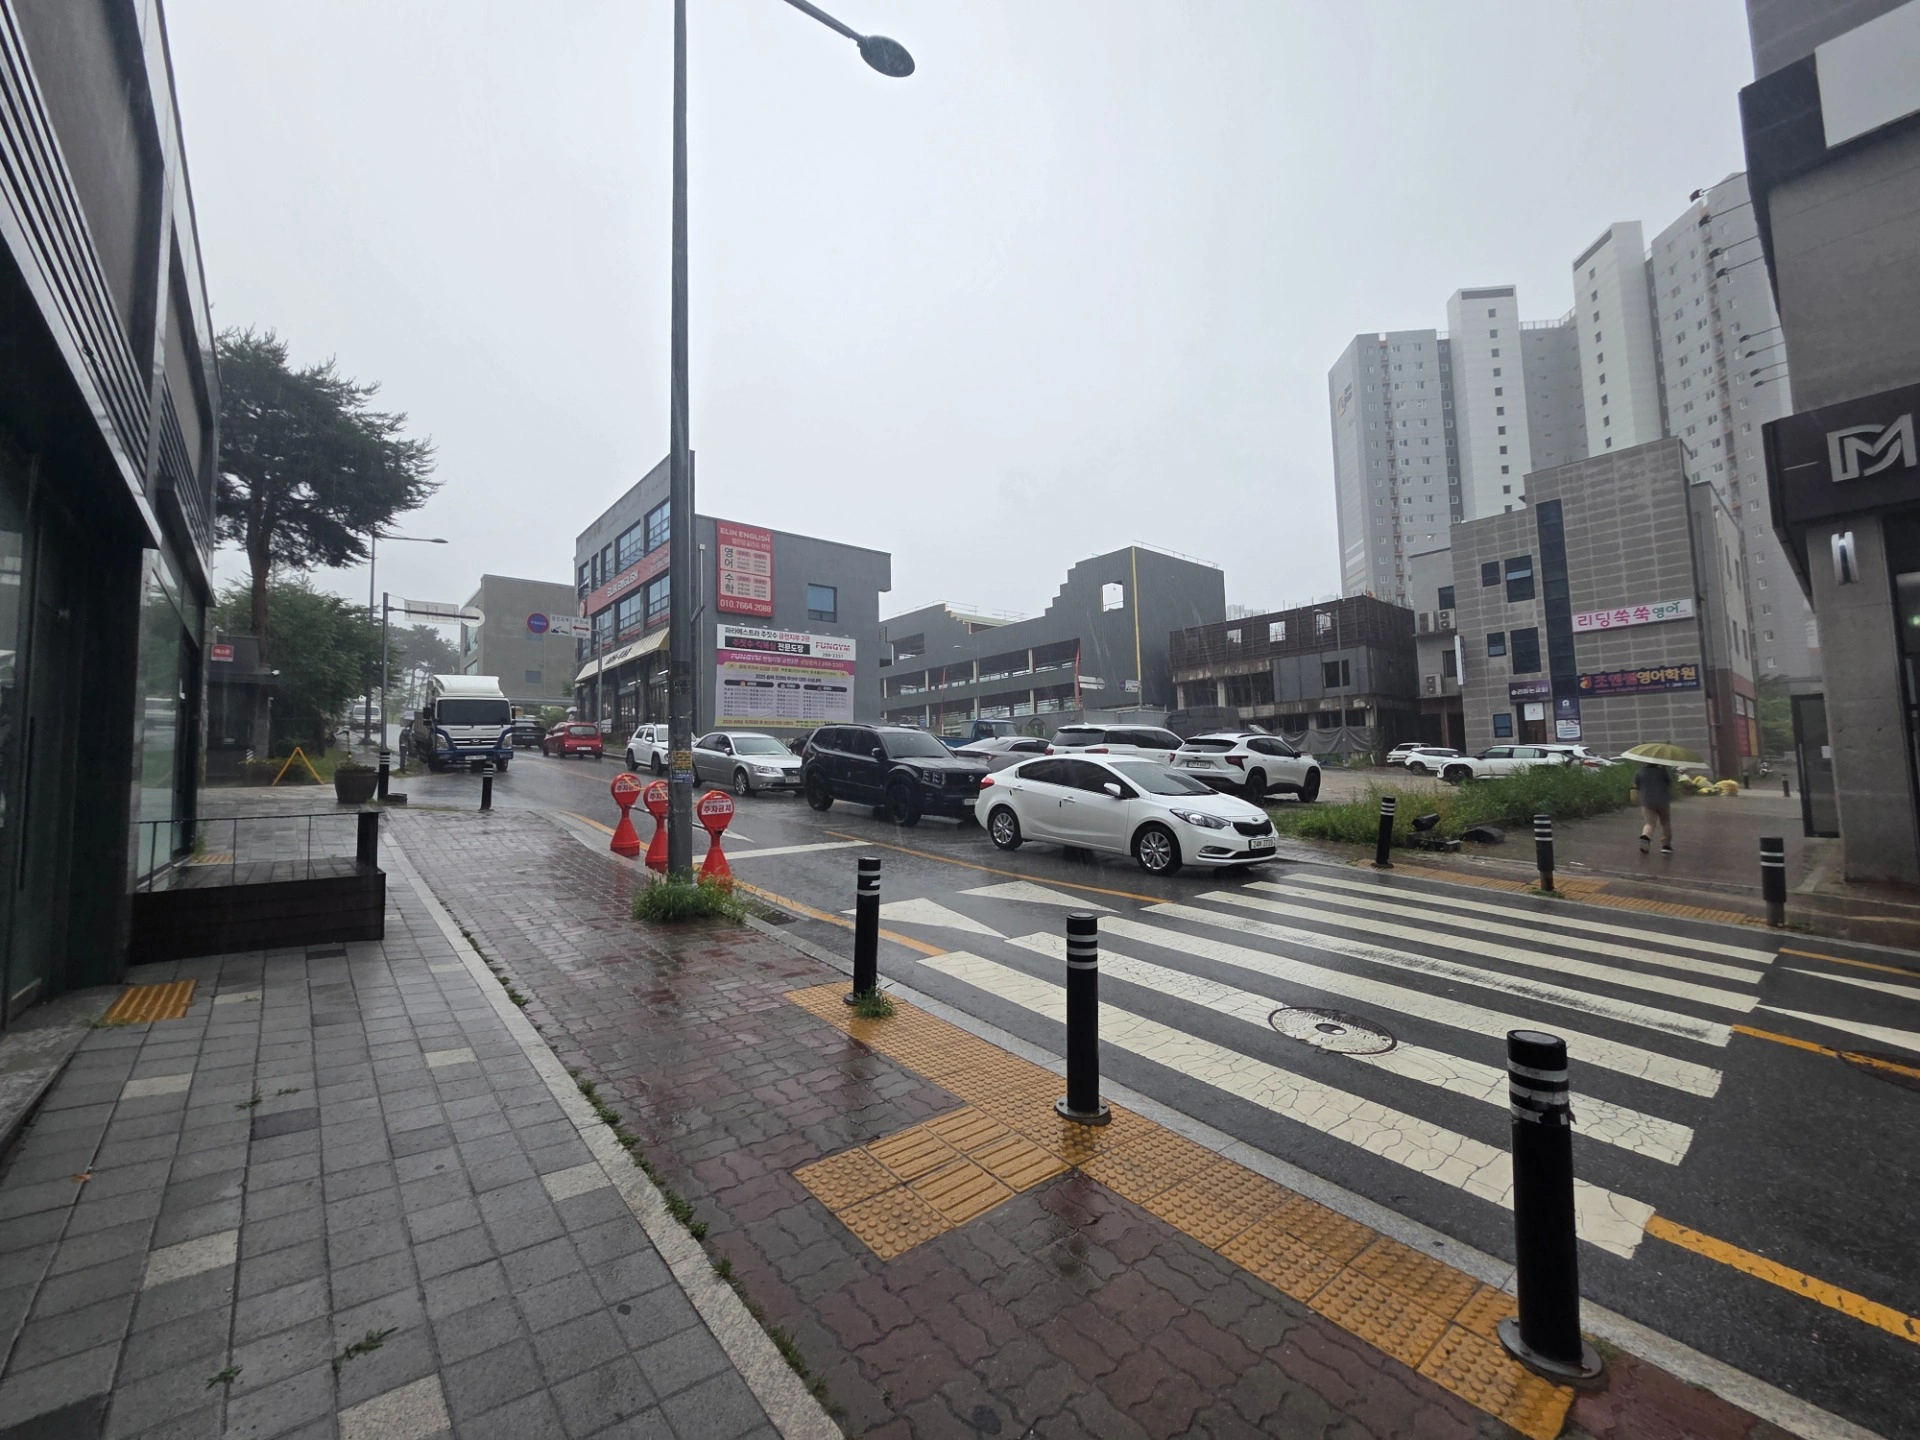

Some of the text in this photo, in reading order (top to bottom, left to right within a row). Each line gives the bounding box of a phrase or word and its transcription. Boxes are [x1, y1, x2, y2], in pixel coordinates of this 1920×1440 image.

[720, 527, 770, 543] ELIN ENGLISH
[724, 547, 734, 569] 영어
[724, 573, 735, 594] 수학
[761, 630, 777, 639] 주짓수
[777, 643, 804, 653] 전문도장
[815, 641, 851, 652] FUNGYM
[703, 804, 731, 813] 주차금지
